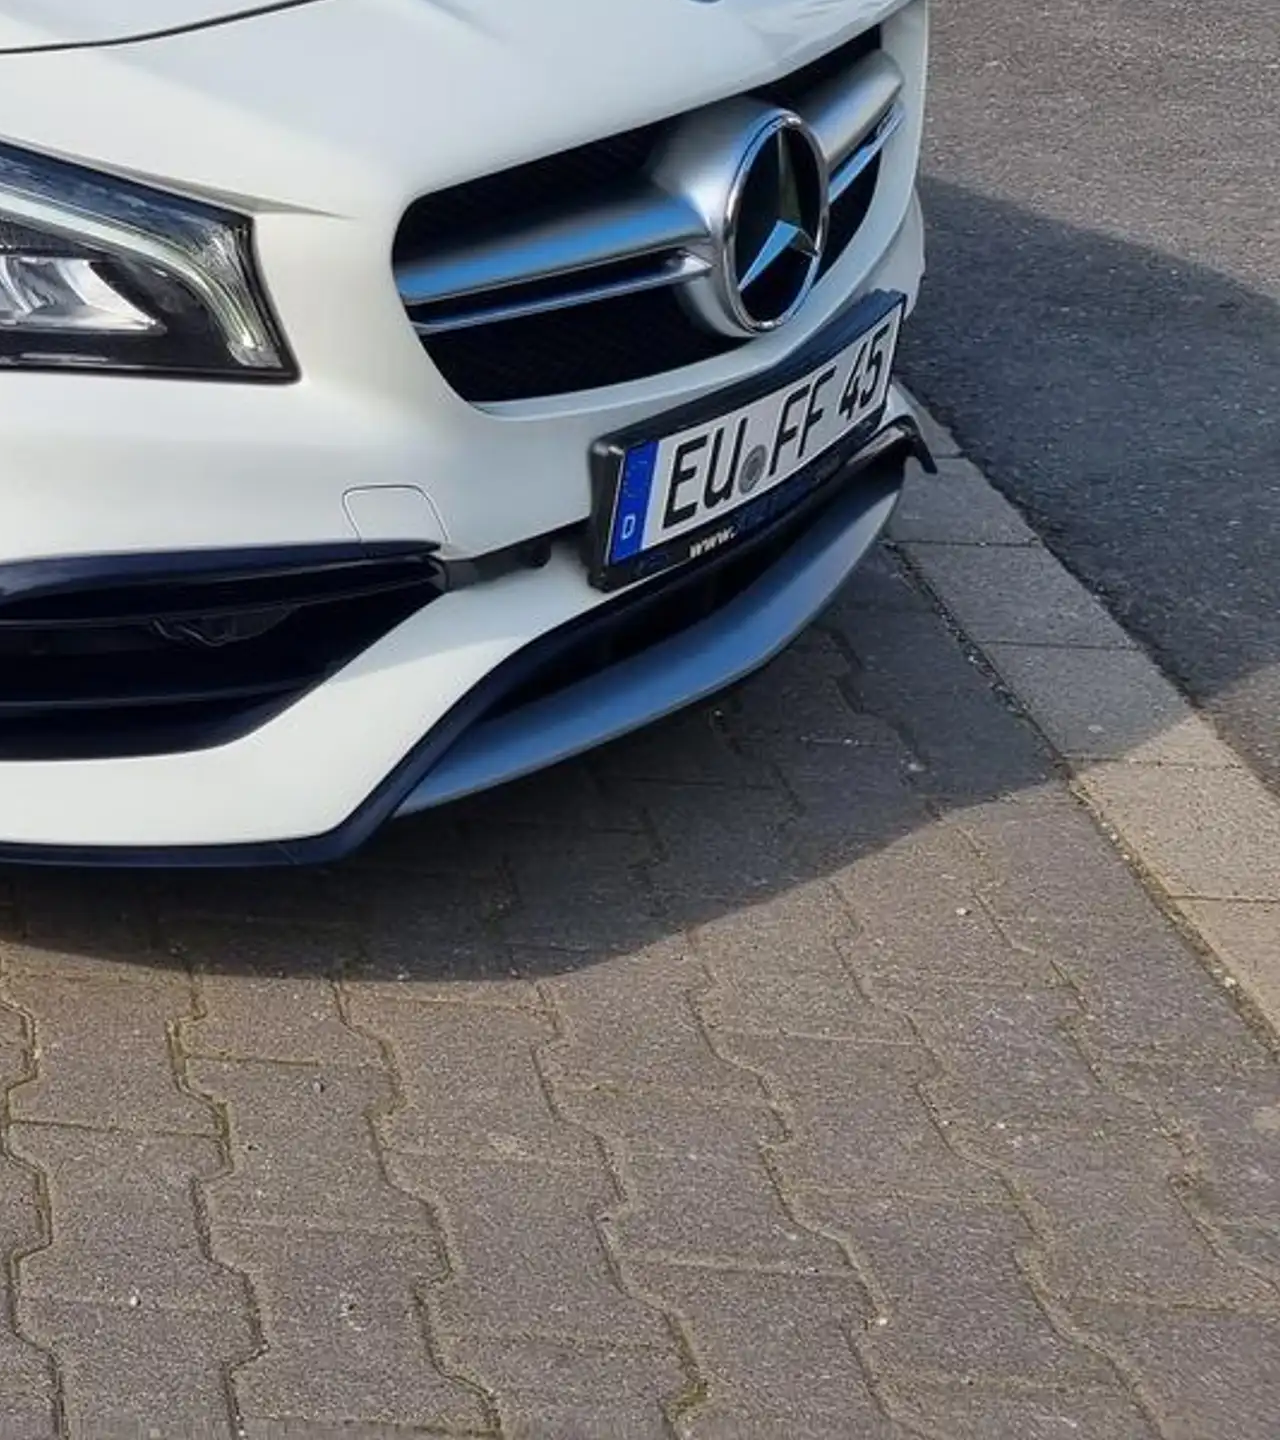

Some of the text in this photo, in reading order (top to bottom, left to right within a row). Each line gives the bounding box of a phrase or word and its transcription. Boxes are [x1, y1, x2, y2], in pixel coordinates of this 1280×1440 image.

[621, 322, 891, 540] D EU FF 45
